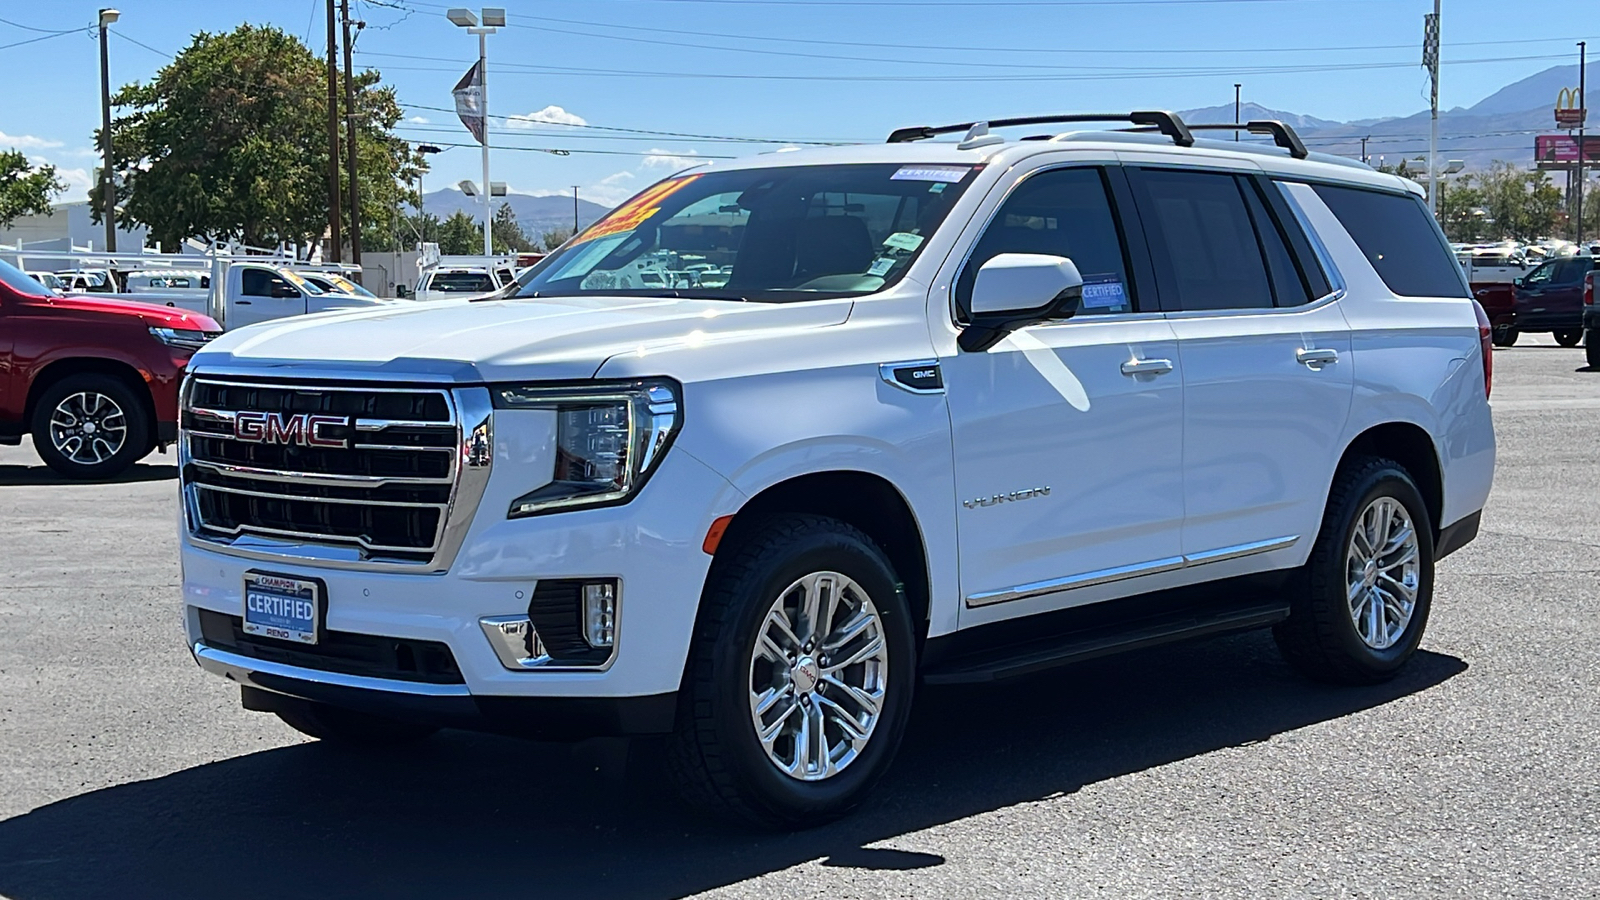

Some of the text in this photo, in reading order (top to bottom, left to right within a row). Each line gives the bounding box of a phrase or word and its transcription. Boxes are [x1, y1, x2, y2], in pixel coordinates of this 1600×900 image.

[898, 168, 961, 178] CERTIFIED
[1083, 285, 1122, 298] CERTIFIED
[913, 370, 936, 379] GMC
[234, 410, 349, 449] GMC
[963, 485, 1051, 509] YUKON
[261, 577, 295, 589] CHAMPION
[248, 593, 314, 621] CERTIFIED
[266, 628, 290, 639] RENO
[800, 665, 816, 684] GMC
